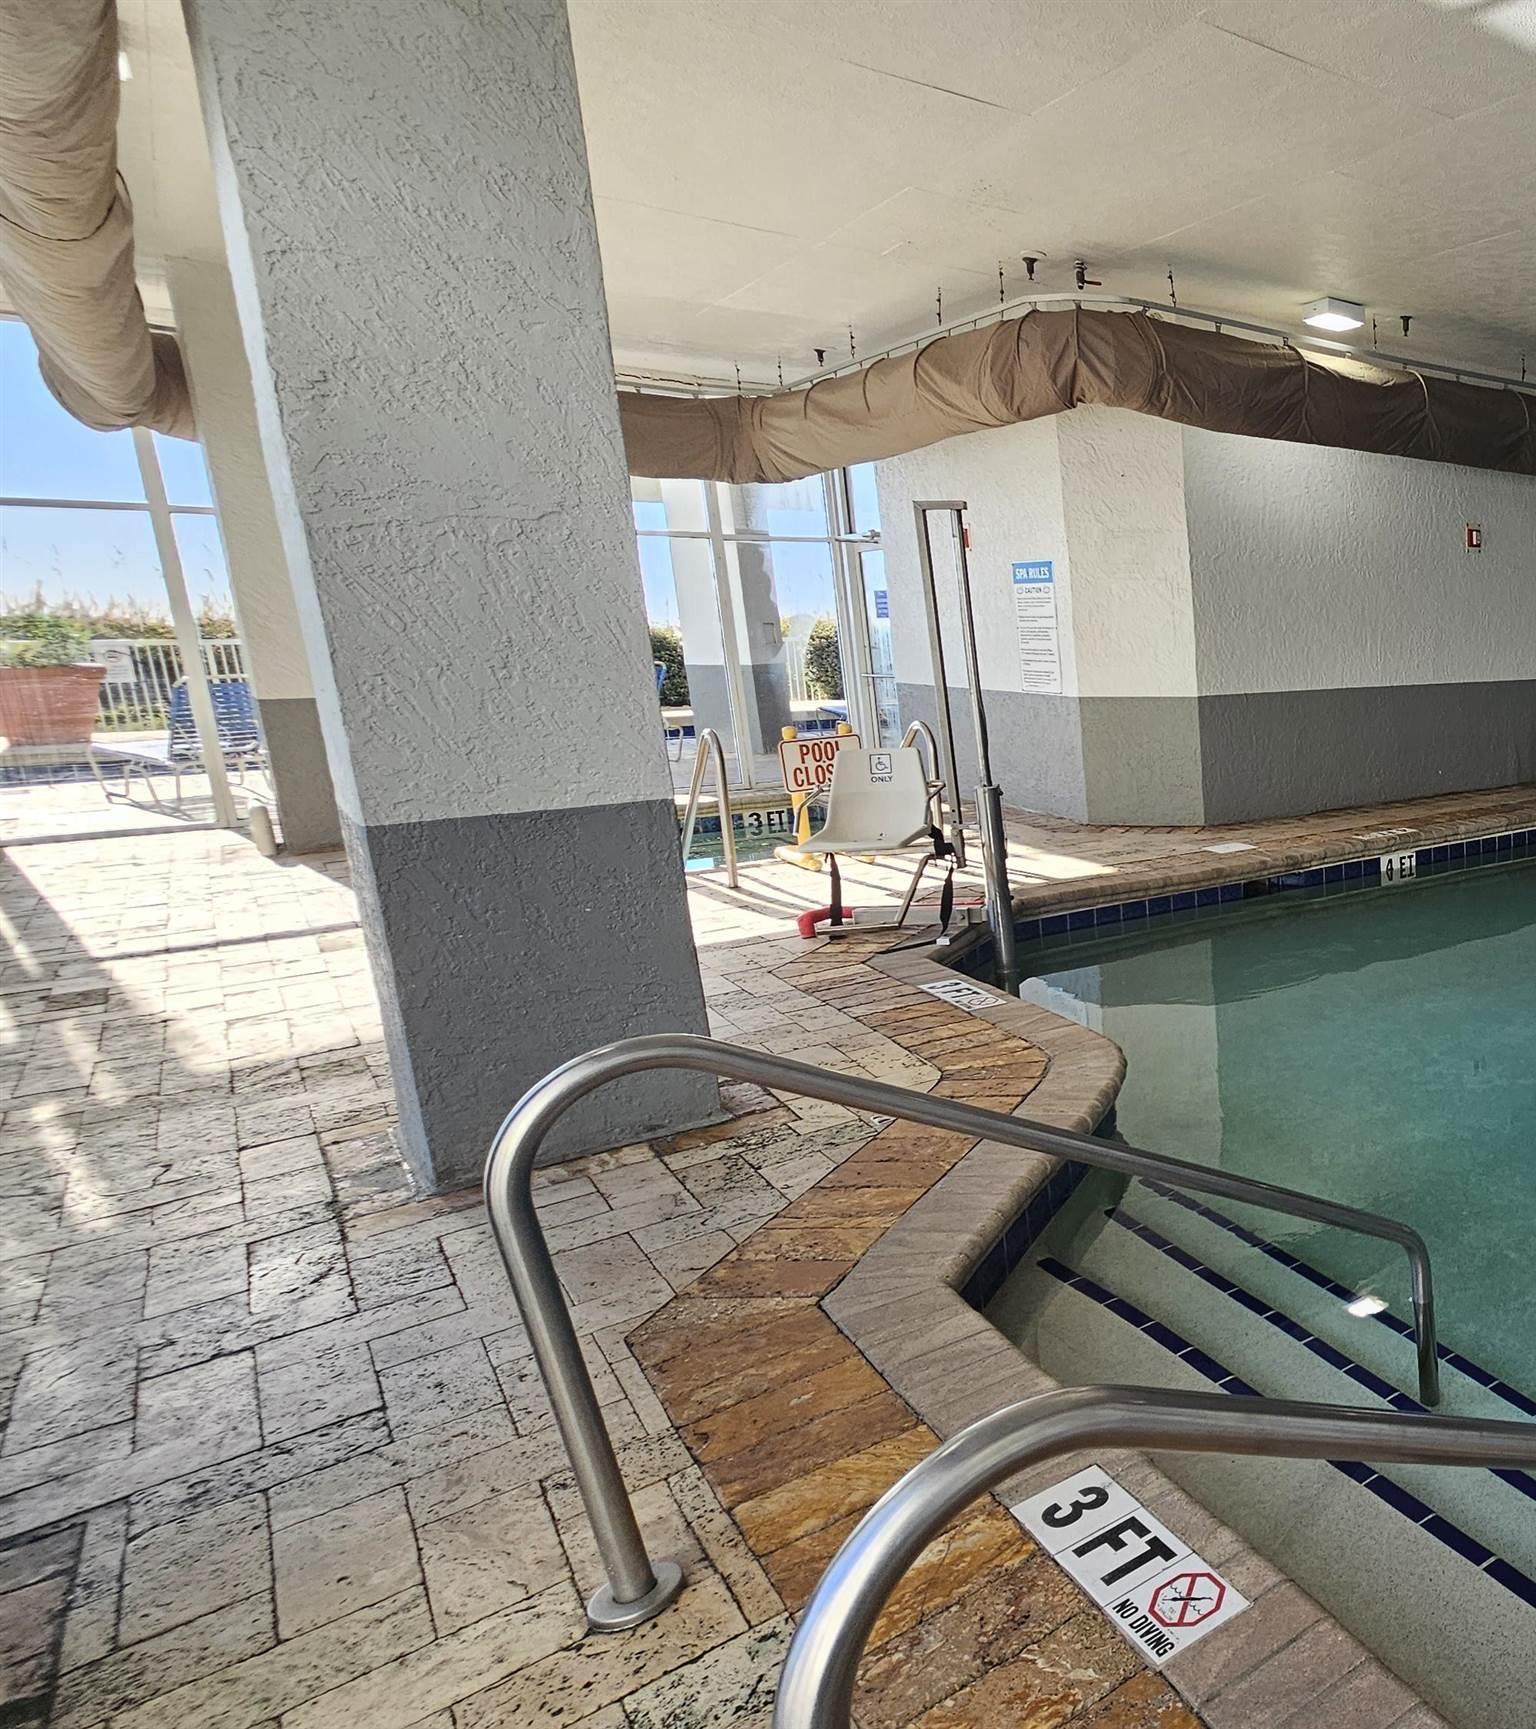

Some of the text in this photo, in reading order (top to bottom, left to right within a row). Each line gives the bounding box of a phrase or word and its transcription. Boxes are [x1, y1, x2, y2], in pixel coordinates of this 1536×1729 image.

[1015, 567, 1050, 580] SPA RULES
[1041, 1486, 1178, 1587] 3 FT
[1112, 1598, 1175, 1658] NO DIVING
